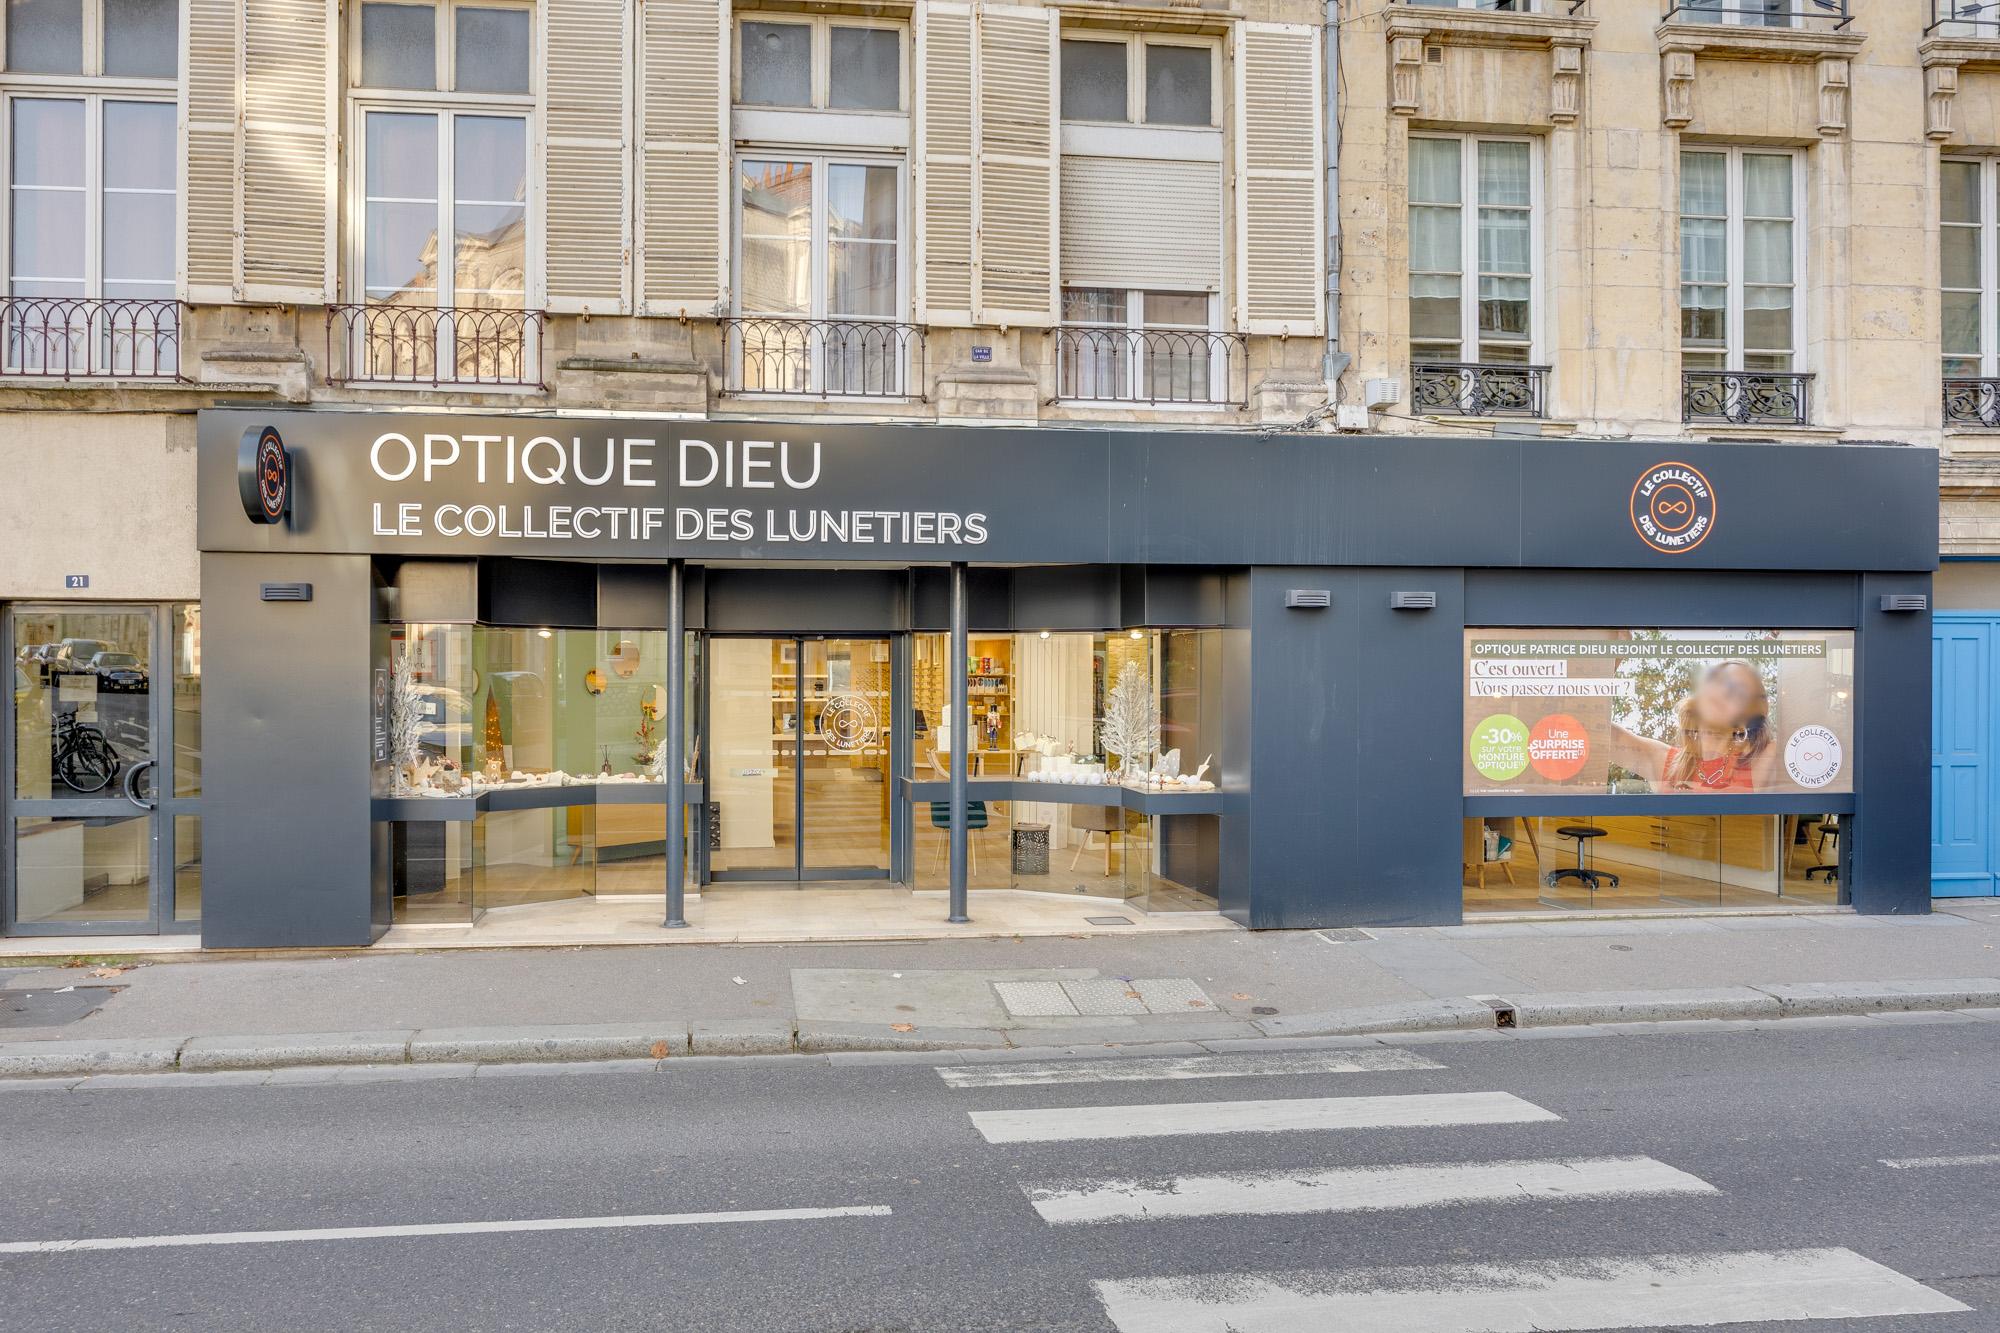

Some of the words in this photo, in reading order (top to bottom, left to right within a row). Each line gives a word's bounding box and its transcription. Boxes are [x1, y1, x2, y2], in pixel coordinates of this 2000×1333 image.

[370, 432, 657, 487] OPTIQUE
[679, 439, 821, 490] DIEU
[1640, 480, 1655, 497] LE
[1652, 469, 1708, 499] COLLECTIF
[373, 502, 423, 536] LE
[434, 504, 665, 540] COLLECTIF
[676, 507, 755, 541] DES
[766, 509, 988, 545] LUNETIERS
[1639, 515, 1657, 536] DES
[1655, 515, 1708, 546] LUNETIERS
[71, 576, 84, 587] 21
[1475, 644, 1526, 656] OPTIQUE
[1529, 644, 1576, 655] PATRICE
[1579, 644, 1607, 655] DIEU
[1612, 644, 1658, 655] REJOINT
[1660, 644, 1673, 655] LE
[1676, 644, 1735, 655] COLLECTIF
[1738, 644, 1759, 655] DES
[1762, 644, 1822, 655] LUNETIERS
[1474, 660, 1508, 676] C'est
[1512, 663, 1556, 676] ouvert
[1475, 681, 1508, 695] Vous
[1511, 683, 1553, 698] passez
[1557, 684, 1590, 695] nous
[1594, 682, 1620, 695] voir
[827, 706, 835, 717] LE
[834, 700, 871, 718] COLLECTIF
[825, 728, 837, 742] DES
[1481, 728, 1523, 744] -30%
[1548, 728, 1569, 739] Une
[1791, 736, 1801, 747] LE
[1799, 728, 1838, 748] COLLECTIF
[1499, 745, 1521, 753] votre
[1532, 739, 1585, 749] SURPRISE
[1478, 752, 1525, 761] MONTURE
[1788, 762, 1801, 778] DES
[1800, 761, 1838, 784] LUNETIERS
